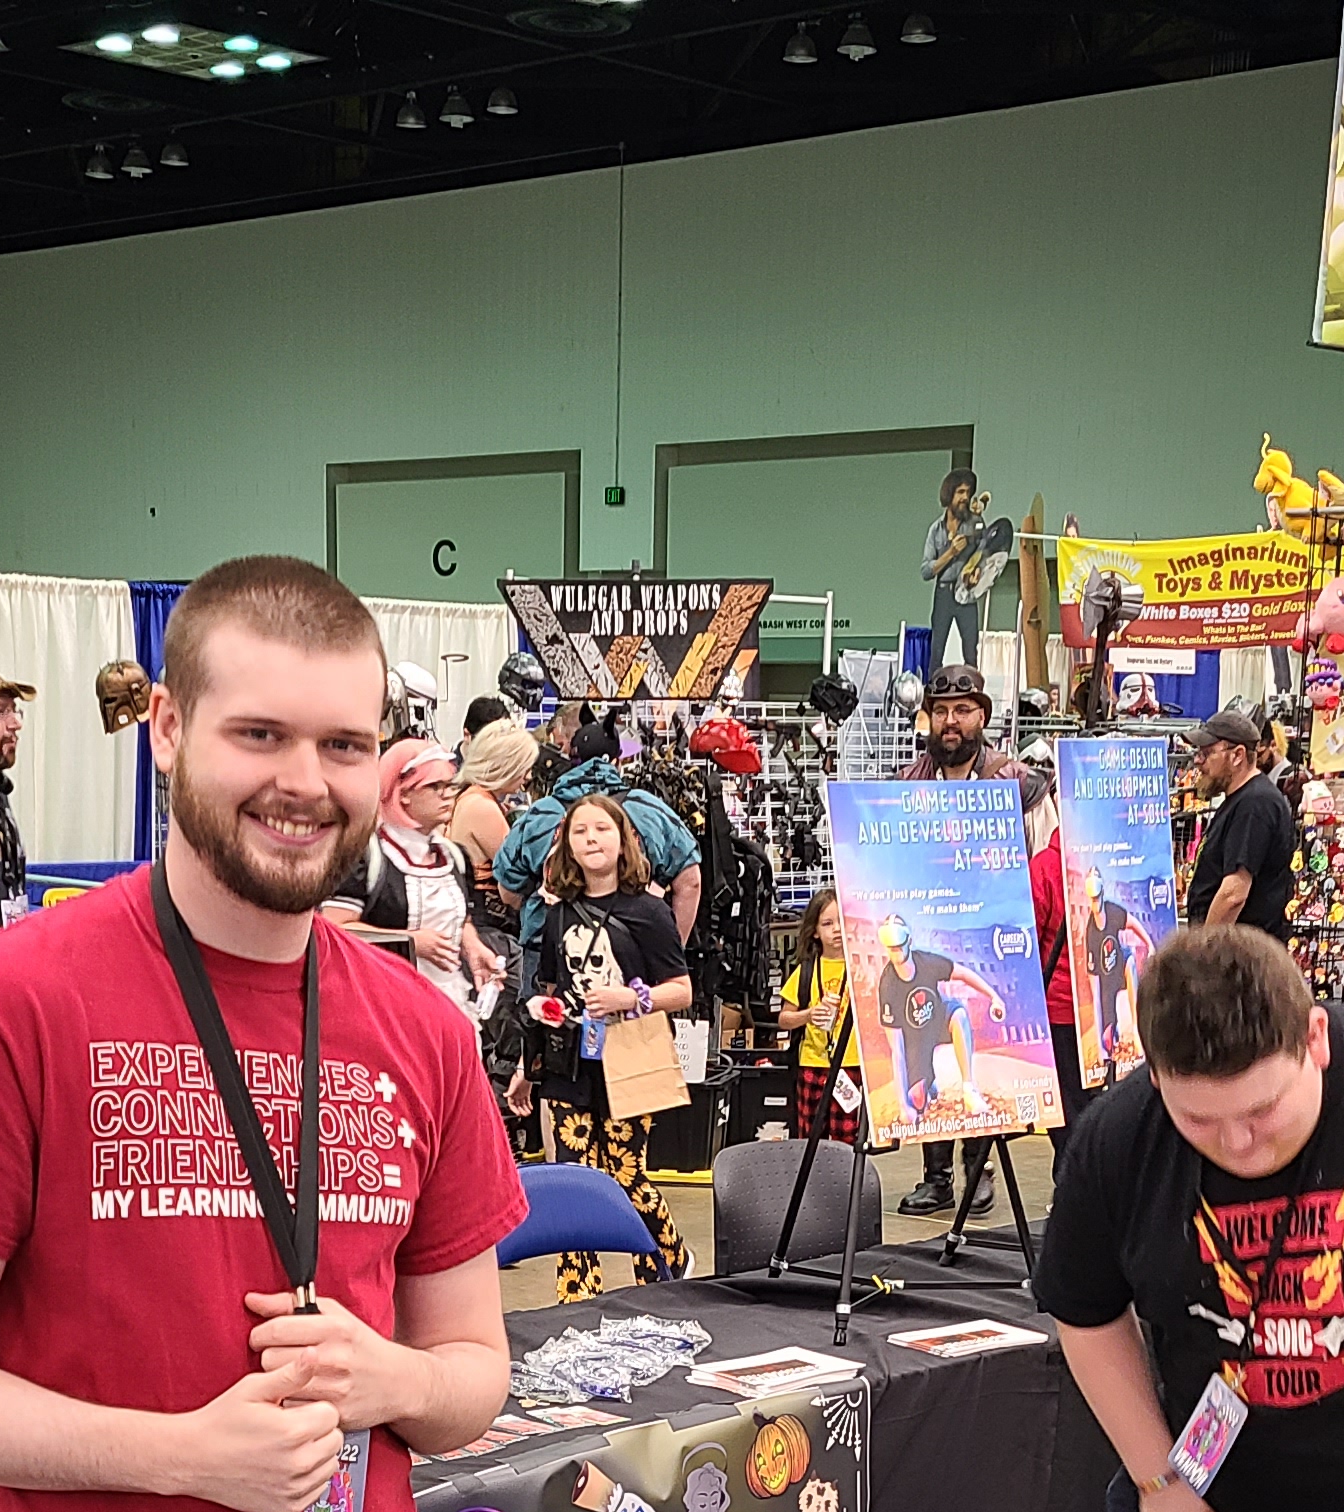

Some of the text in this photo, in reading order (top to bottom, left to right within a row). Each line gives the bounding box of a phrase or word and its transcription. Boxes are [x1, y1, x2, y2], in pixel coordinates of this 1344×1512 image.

[432, 540, 458, 576] C
[1168, 541, 1308, 576] Imaginarium
[1154, 568, 1318, 597] Toys & Mystery
[550, 583, 721, 611] WULFGAR WEAPONS
[1139, 600, 1315, 620] White Boxes $20 Gold Boxe
[590, 609, 688, 635] AND PROPS
[786, 620, 807, 628] WEST
[1099, 747, 1164, 770] GAME DESIGN
[901, 788, 1015, 813] GAME DESIGN
[1074, 775, 1165, 800] AND DEVELOPMENT
[1127, 802, 1167, 827] AT SOIC
[859, 818, 1016, 845] AND DEVELOPMENT
[954, 847, 1021, 871] AT SOIC
[892, 890, 908, 901] just
[910, 889, 926, 900] play
[936, 904, 957, 914] make
[90, 1189, 134, 1220] MY
[1226, 1208, 1330, 1247] WELOME
[1265, 1318, 1313, 1357] SOIC
[1265, 1367, 1322, 1398] TOUR
